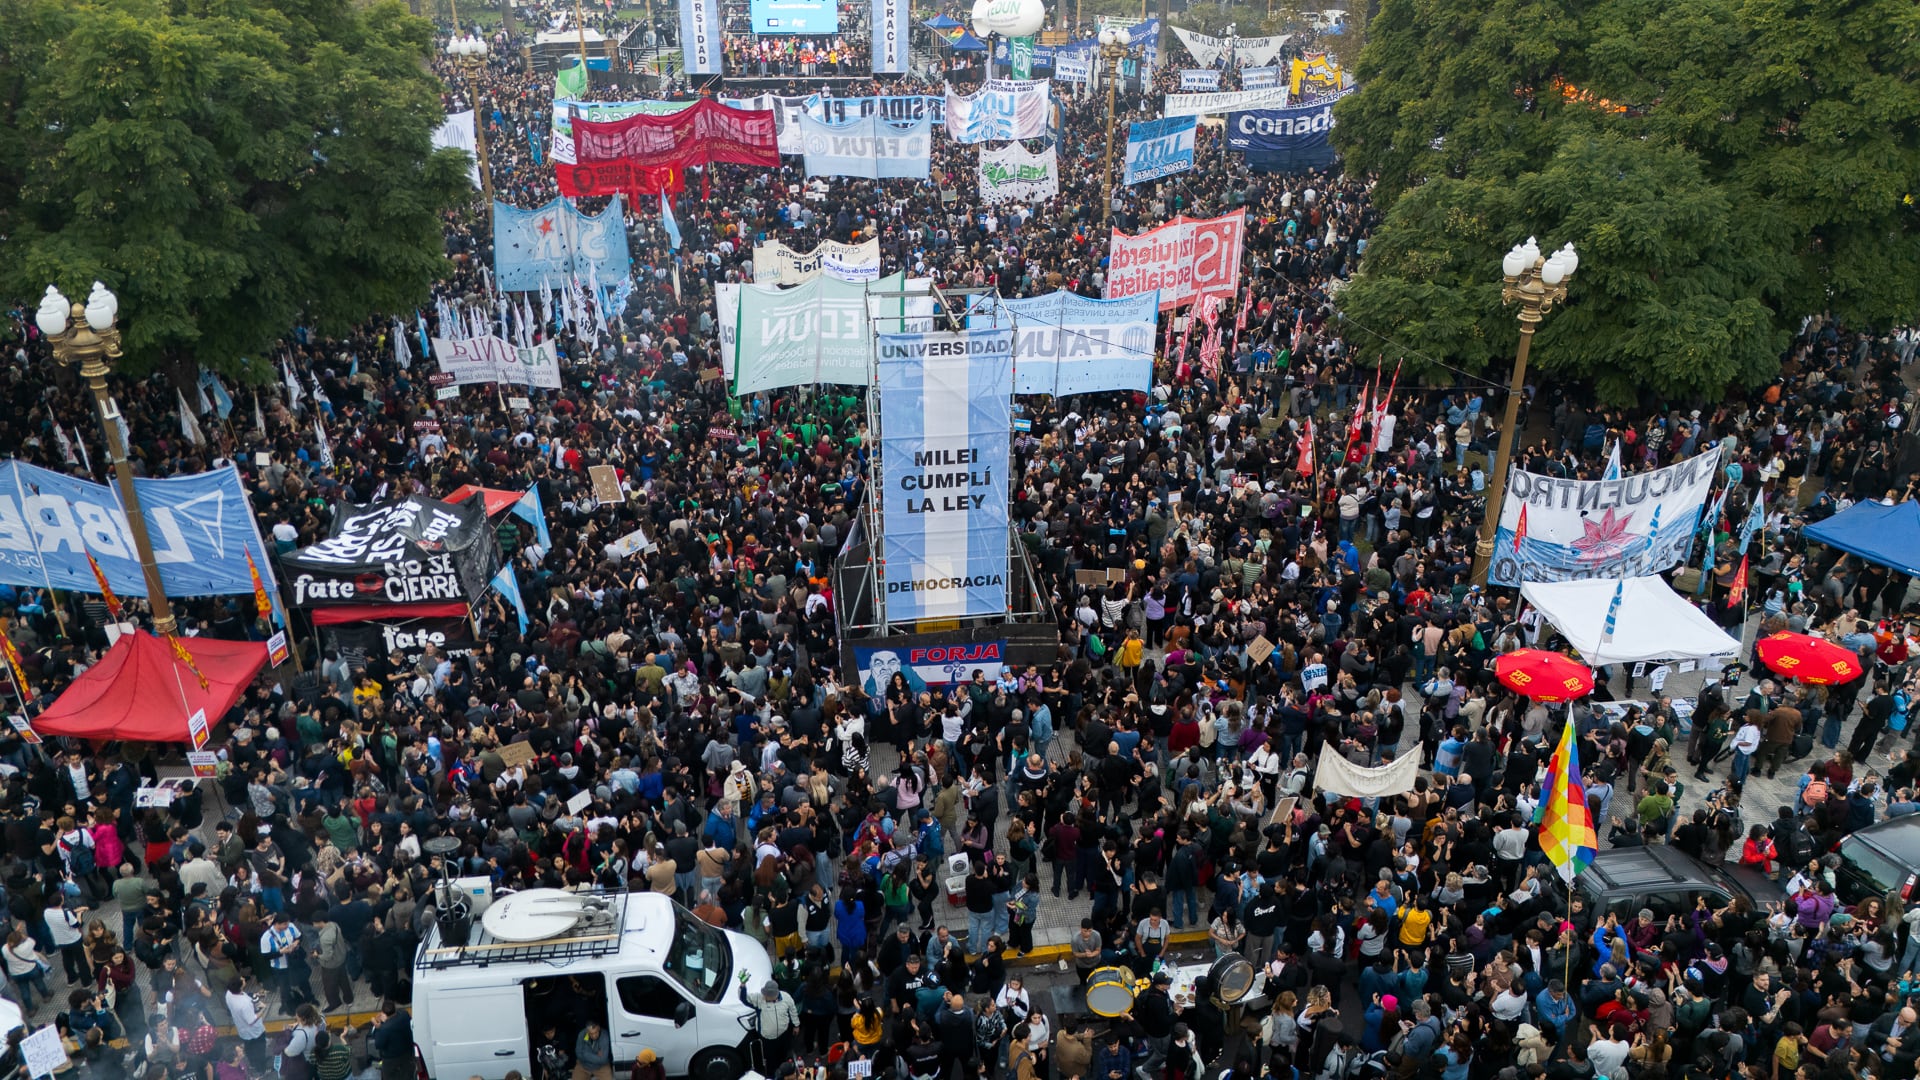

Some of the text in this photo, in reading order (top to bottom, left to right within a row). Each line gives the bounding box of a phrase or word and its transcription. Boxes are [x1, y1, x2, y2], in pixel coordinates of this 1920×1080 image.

[882, 339, 1009, 359] UNIVERSIDAD
[914, 448, 979, 467] MILEI
[900, 465, 992, 491] CUMPLÍ
[907, 493, 986, 514] LA LEY
[384, 553, 455, 577] NO SE
[293, 575, 355, 605] fate
[384, 574, 462, 602] CIERRA
[888, 573, 1003, 594] DEMOCRACIA
[382, 625, 446, 652] fate
[910, 642, 1000, 664] FORJA
